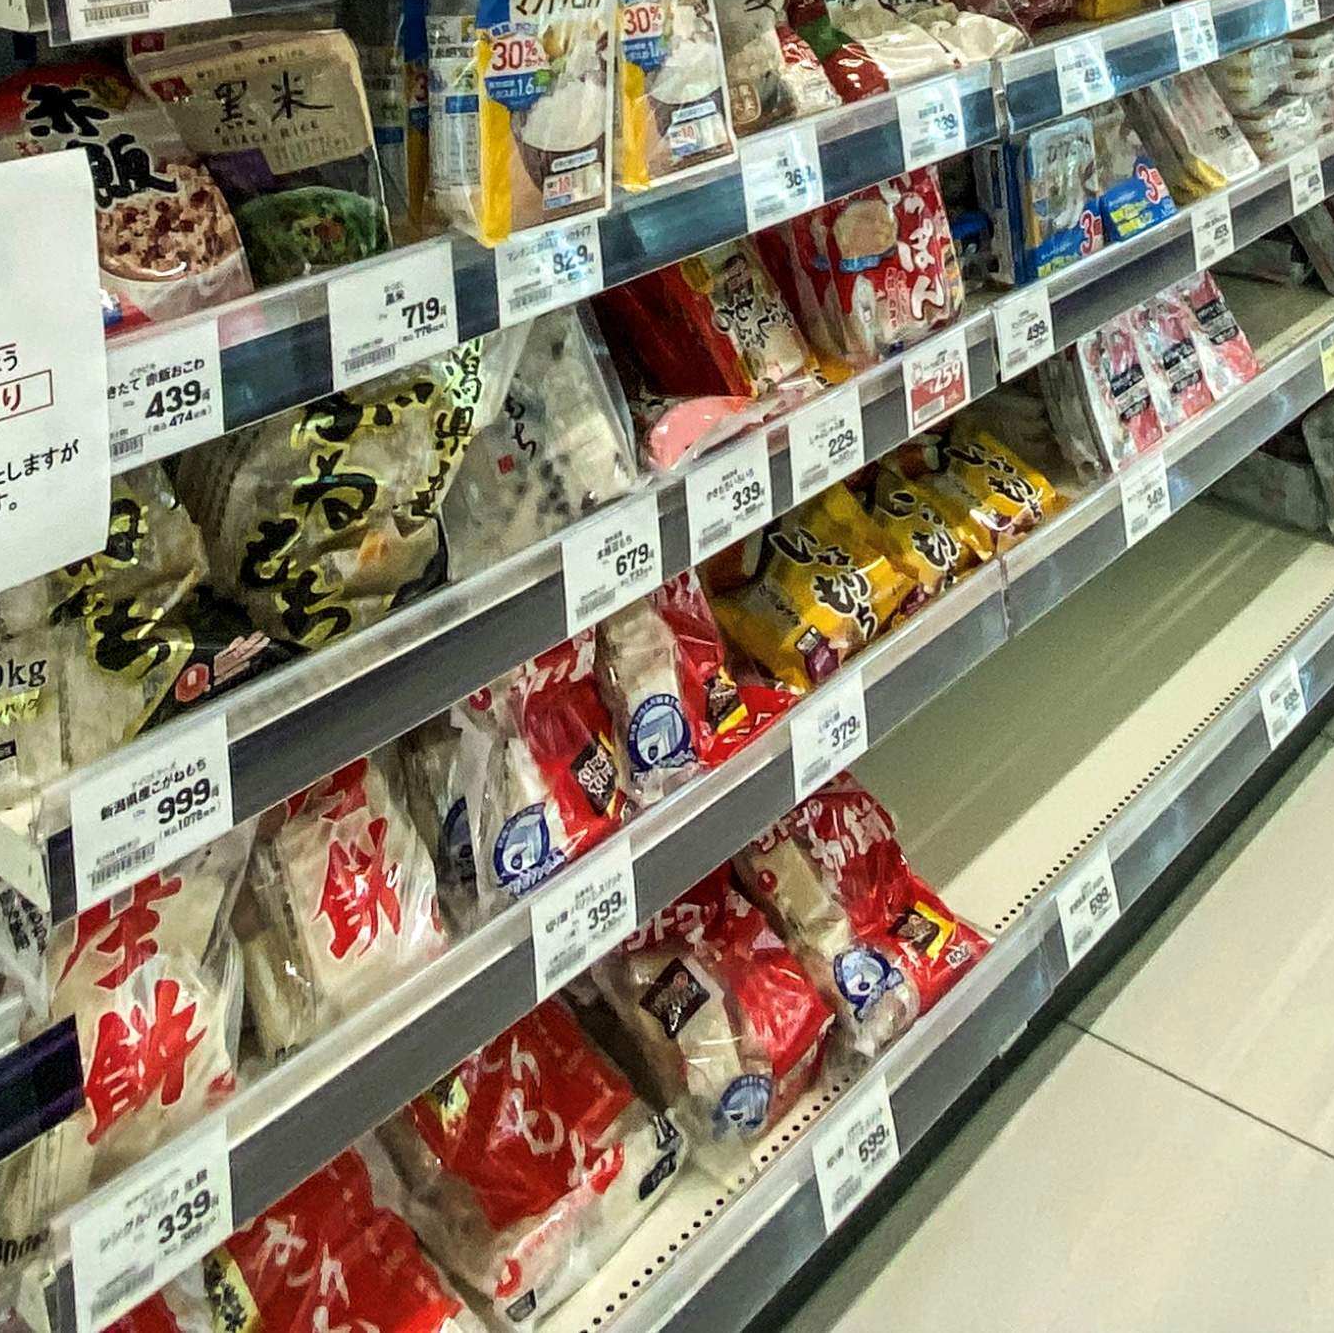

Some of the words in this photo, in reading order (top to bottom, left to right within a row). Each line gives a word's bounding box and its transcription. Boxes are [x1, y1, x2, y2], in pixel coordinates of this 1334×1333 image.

[623, 4, 662, 36] 30%
[491, 39, 538, 72] 30%
[213, 70, 335, 134] 黒米
[145, 358, 206, 387] 赤飯おこわ
[934, 361, 962, 394] 259
[504, 397, 537, 459] もち
[52, 872, 208, 1146] 生餅
